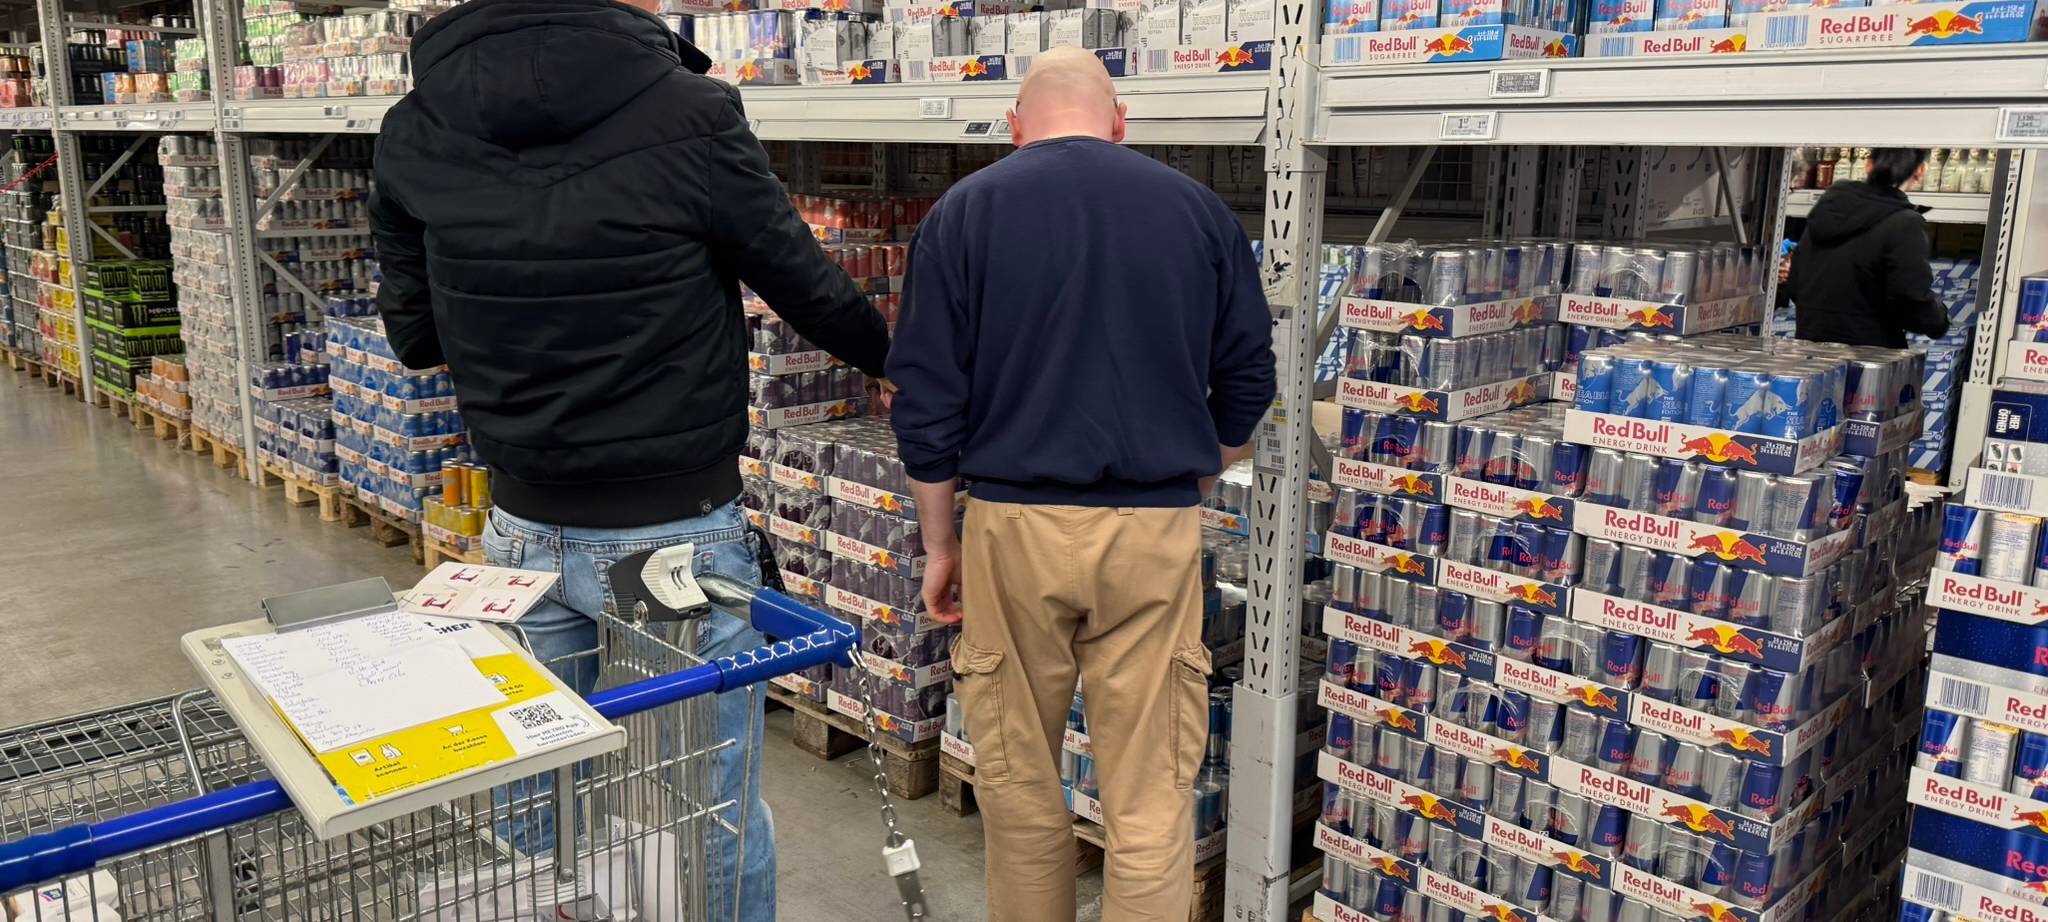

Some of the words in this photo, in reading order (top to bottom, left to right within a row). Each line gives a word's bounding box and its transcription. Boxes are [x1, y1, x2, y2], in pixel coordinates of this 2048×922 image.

[1821, 18, 1854, 34] Red
[1858, 15, 1894, 32] Bull
[1370, 38, 1391, 52] Red
[1394, 36, 1416, 50] Bull
[1511, 34, 1523, 49] Red
[1524, 36, 1539, 50] Bull
[1643, 40, 1670, 53] Red
[1672, 38, 1701, 52] Bull
[1820, 35, 1893, 44] SUGARFREE
[1174, 50, 1190, 62] Red
[1193, 49, 1210, 61] Bull
[1347, 304, 1369, 317] Red
[1370, 307, 1392, 319] Bull
[1470, 307, 1489, 321] Red
[1489, 304, 1505, 318] Bull
[1568, 300, 1591, 314] Red
[1594, 303, 1617, 316] Bull
[785, 355, 802, 365] Red
[803, 352, 820, 364] Bull
[2025, 349, 2048, 365] Re
[1343, 382, 1365, 395] Red
[1366, 386, 1387, 399] Bull
[1464, 392, 1482, 407] Red
[1483, 388, 1499, 403] Bull
[784, 409, 801, 419] Red
[803, 405, 819, 416] Bull
[1594, 417, 1629, 437] Red
[1632, 421, 1668, 443] Bull
[1593, 437, 1632, 448] ENERGY
[1636, 443, 1667, 454] DRINK
[1339, 463, 1360, 476] Red
[1362, 467, 1384, 481] Bull
[841, 482, 854, 494] Red
[856, 485, 869, 499] Bull
[1455, 483, 1478, 498] Red
[1481, 487, 1505, 503] Bull
[1605, 510, 1642, 530] Red
[1644, 516, 1679, 538] Bull
[838, 537, 851, 549] Red
[852, 542, 865, 555] Bull
[1331, 538, 1352, 553] Red
[1354, 542, 1375, 558] Bull
[1604, 529, 1644, 541] ENERGY
[1647, 536, 1677, 550] DRINK
[1448, 565, 1471, 581] Red
[1473, 571, 1498, 587] Bull
[837, 591, 851, 604] Red
[852, 596, 867, 608] Bull
[1944, 578, 1981, 599] Red
[1985, 586, 2022, 606] Bull
[1604, 599, 1638, 622] Red
[1641, 608, 1677, 630] Bull
[1943, 595, 1983, 608] ENERGY
[1988, 604, 2020, 615] DRINK
[1345, 615, 1370, 635] Red
[1374, 623, 1399, 643] Bull
[1602, 618, 1641, 633] ENERGY
[1645, 629, 1675, 641] DRINK
[1504, 663, 1529, 680] Red
[1532, 671, 1556, 688] Bull
[1325, 687, 1345, 705] Red
[1347, 696, 1367, 710] Bull
[2007, 696, 2046, 719] Red
[1642, 701, 1670, 721] Red
[1673, 710, 1701, 730] Bull
[1436, 723, 1458, 741] Red
[1461, 733, 1483, 749] Bull
[1339, 762, 1364, 783] Red
[1367, 773, 1391, 794] Bull
[1581, 768, 1615, 792] Red
[1617, 778, 1650, 804] Bull
[1580, 787, 1617, 804] ENERGY
[1620, 799, 1648, 814] DRINK
[1926, 778, 1963, 799] Red
[1966, 789, 2001, 811] Bull
[1925, 794, 1964, 810] ENERGY
[1969, 806, 2000, 819] DRINK
[1321, 830, 1340, 846] Red
[1342, 840, 1361, 856] Bull
[1492, 822, 1516, 841] Red
[1518, 833, 1542, 851] Bull
[1427, 875, 1449, 893] Red
[1451, 885, 1473, 903] Bull
[1624, 871, 1651, 891] Red
[1654, 881, 1681, 902] Bull
